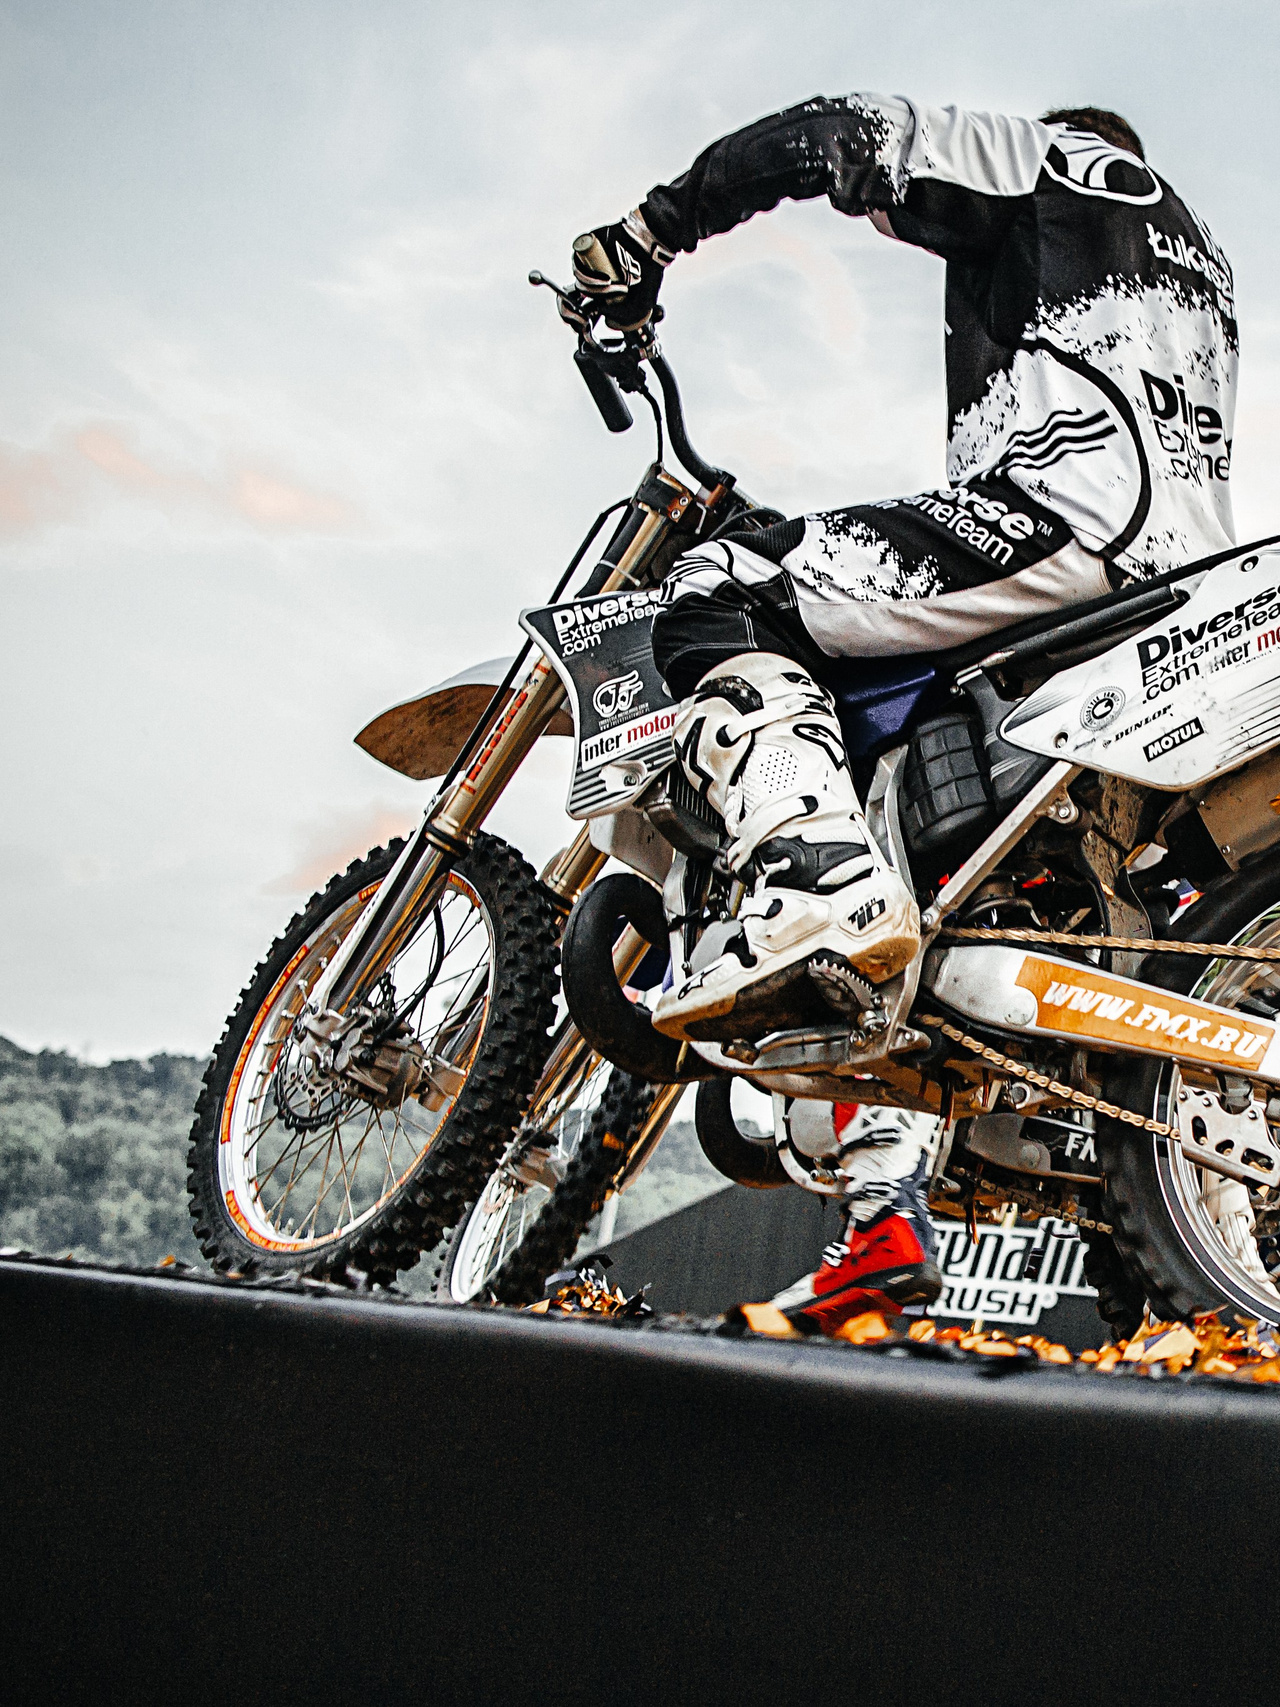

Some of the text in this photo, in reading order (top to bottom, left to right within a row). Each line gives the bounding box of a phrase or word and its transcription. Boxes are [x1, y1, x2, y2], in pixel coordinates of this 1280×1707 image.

[562, 633, 602, 657] .com
[1142, 662, 1201, 704] .com
[584, 733, 623, 762] inter
[627, 712, 678, 744] motor
[1115, 704, 1173, 742] DUNLOP
[1147, 719, 1201, 760] MOTUL
[1042, 981, 1268, 1058] WWW.FMX.RU
